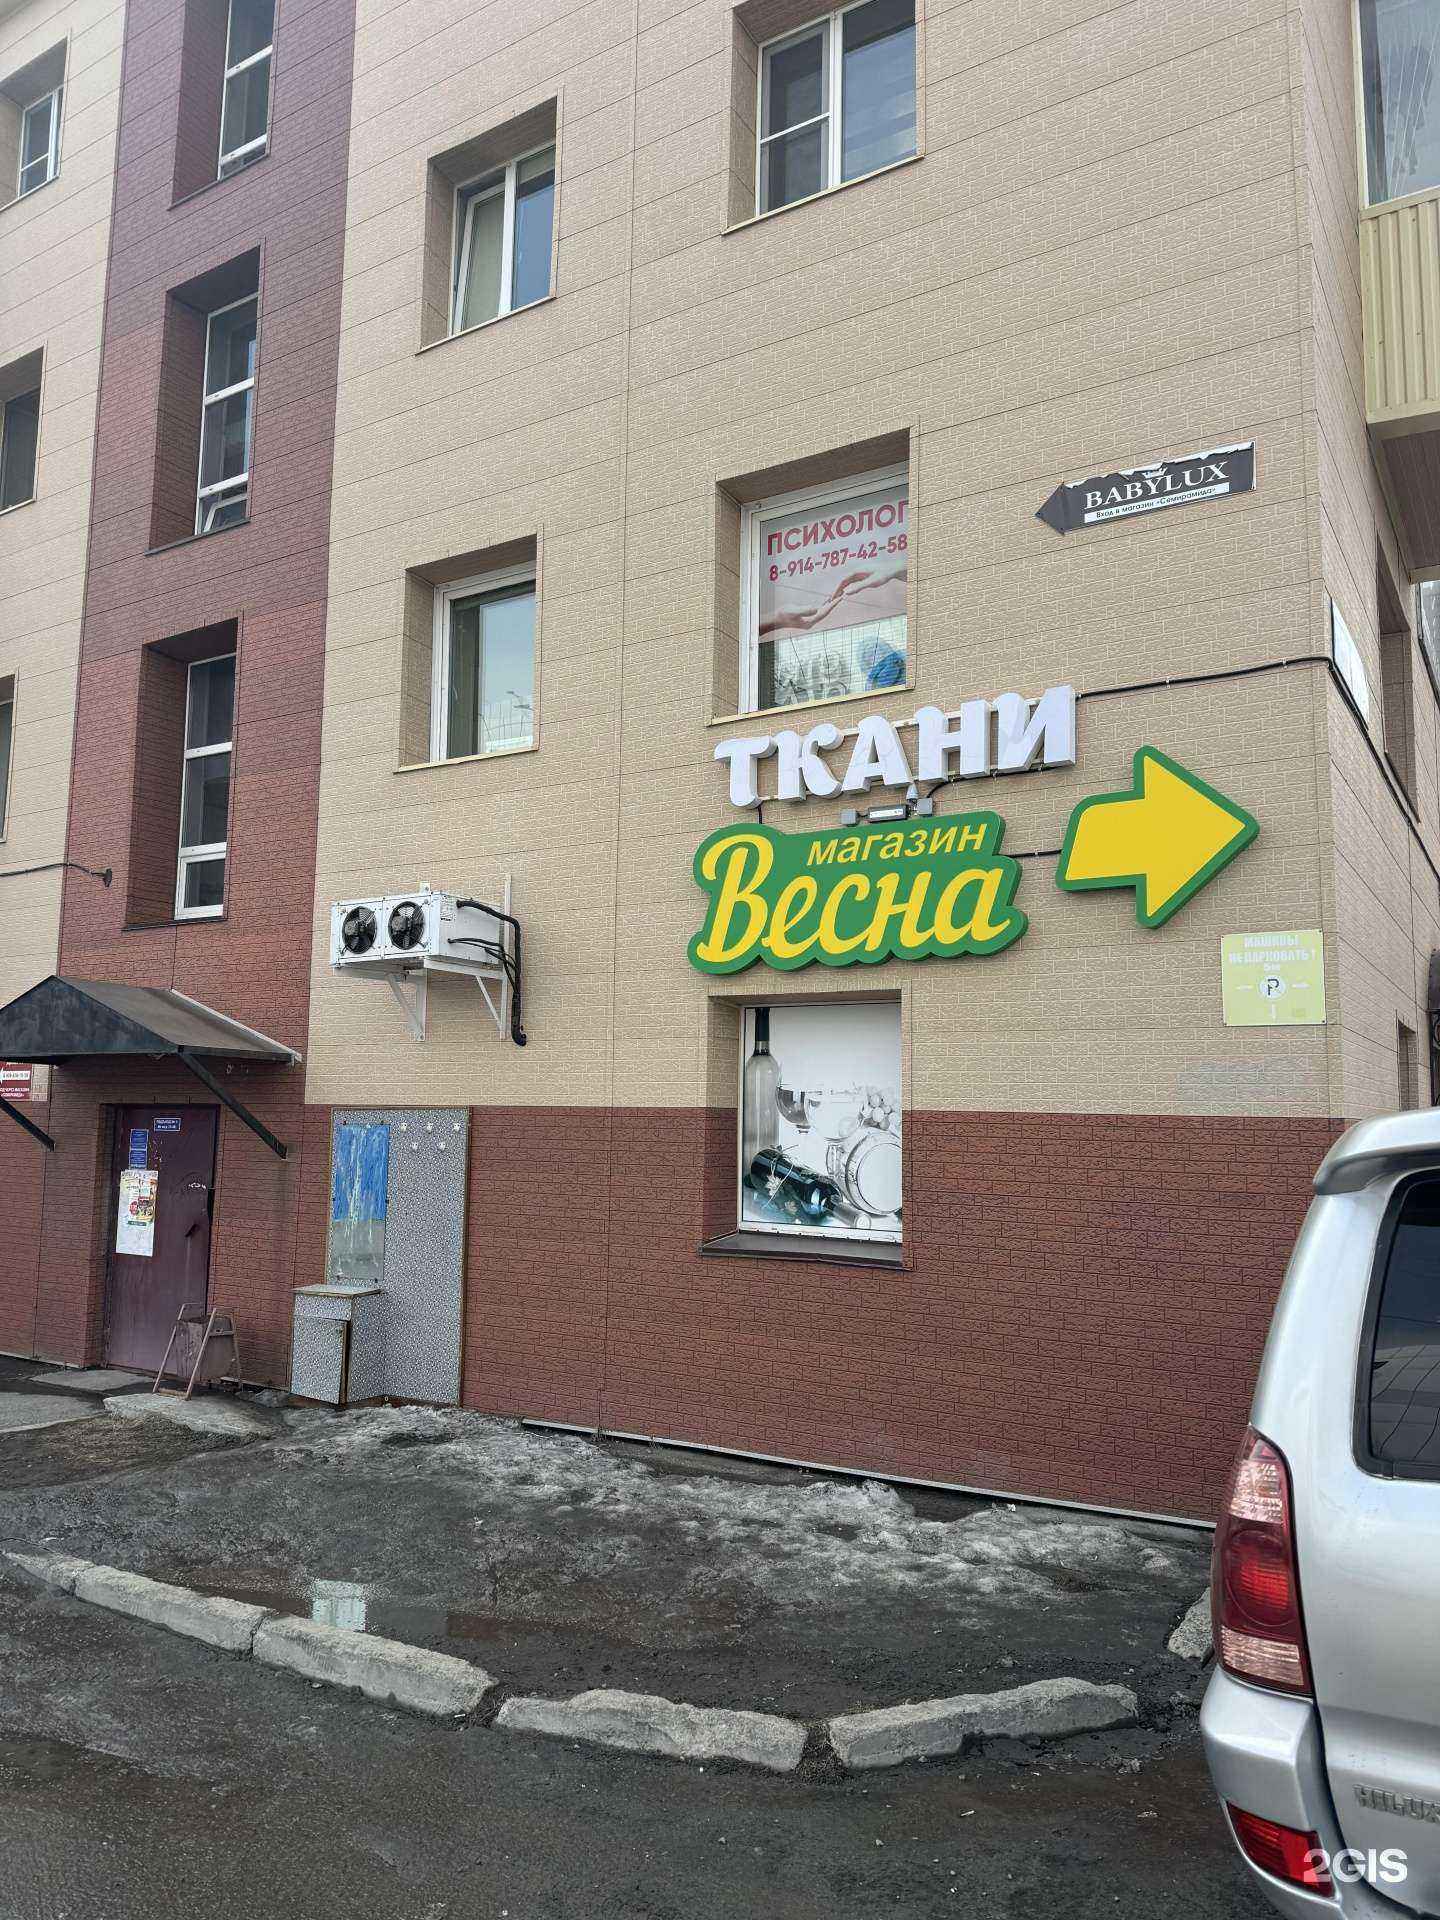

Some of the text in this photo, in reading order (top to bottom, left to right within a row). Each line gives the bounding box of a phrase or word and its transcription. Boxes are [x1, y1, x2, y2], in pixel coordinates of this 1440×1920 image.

[1084, 461, 1229, 509] BABYLUX
[767, 499, 909, 556] ПСИХОЛОГ
[1096, 509, 1114, 519] Вход
[1121, 501, 1154, 513] магазин
[769, 533, 908, 581] 8-914-787-42-58
[714, 685, 1075, 808] ТКАНИ
[806, 823, 988, 866] магазин
[696, 833, 1011, 963] Весна
